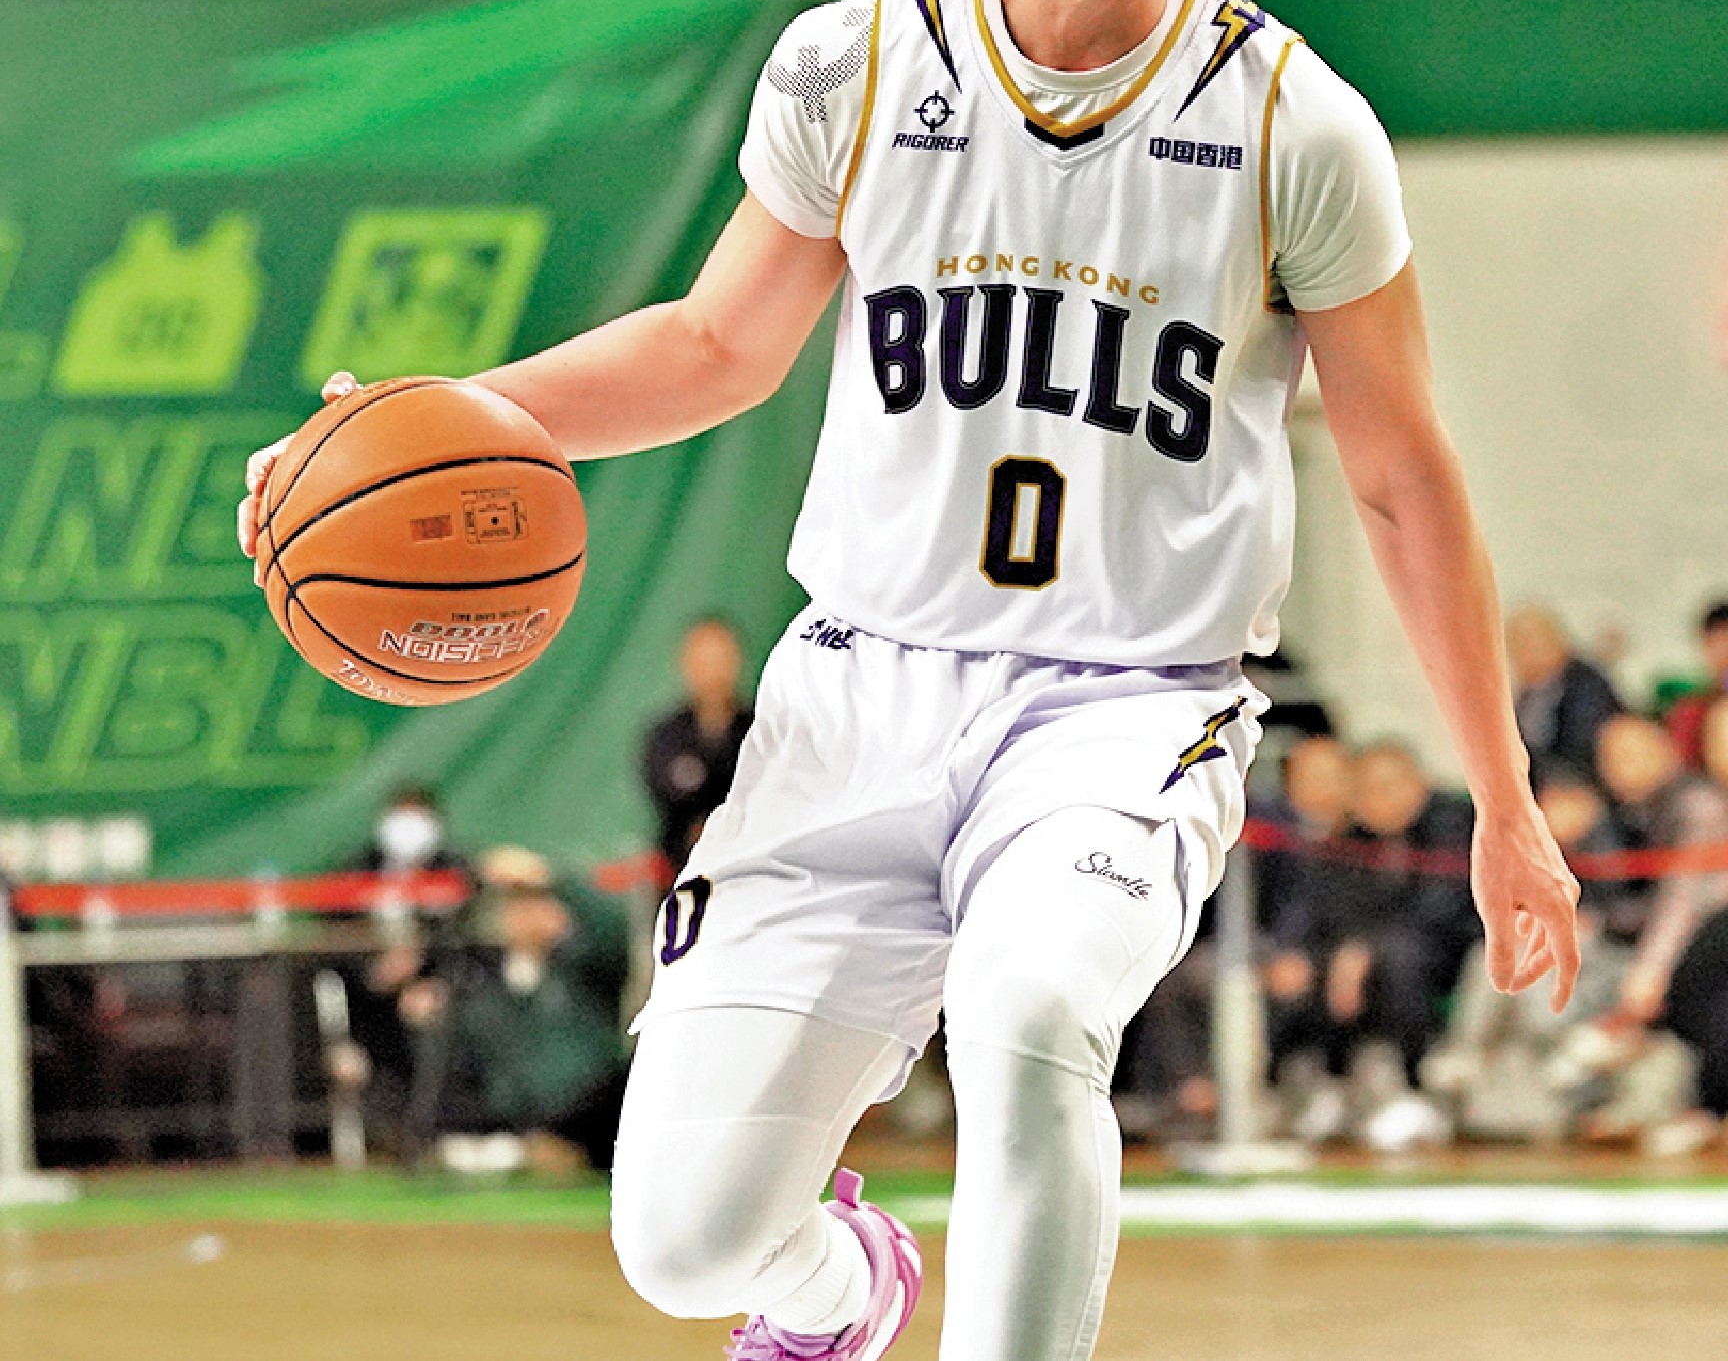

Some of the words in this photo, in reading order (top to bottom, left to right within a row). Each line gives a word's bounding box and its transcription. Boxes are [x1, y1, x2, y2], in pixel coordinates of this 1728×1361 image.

[891, 132, 970, 152] RIGORER
[1148, 136, 1243, 170] 中国香港
[936, 253, 1040, 278] HONG
[1053, 260, 1160, 305] KONG
[863, 283, 1225, 463] BULLS
[978, 454, 1068, 592] 0
